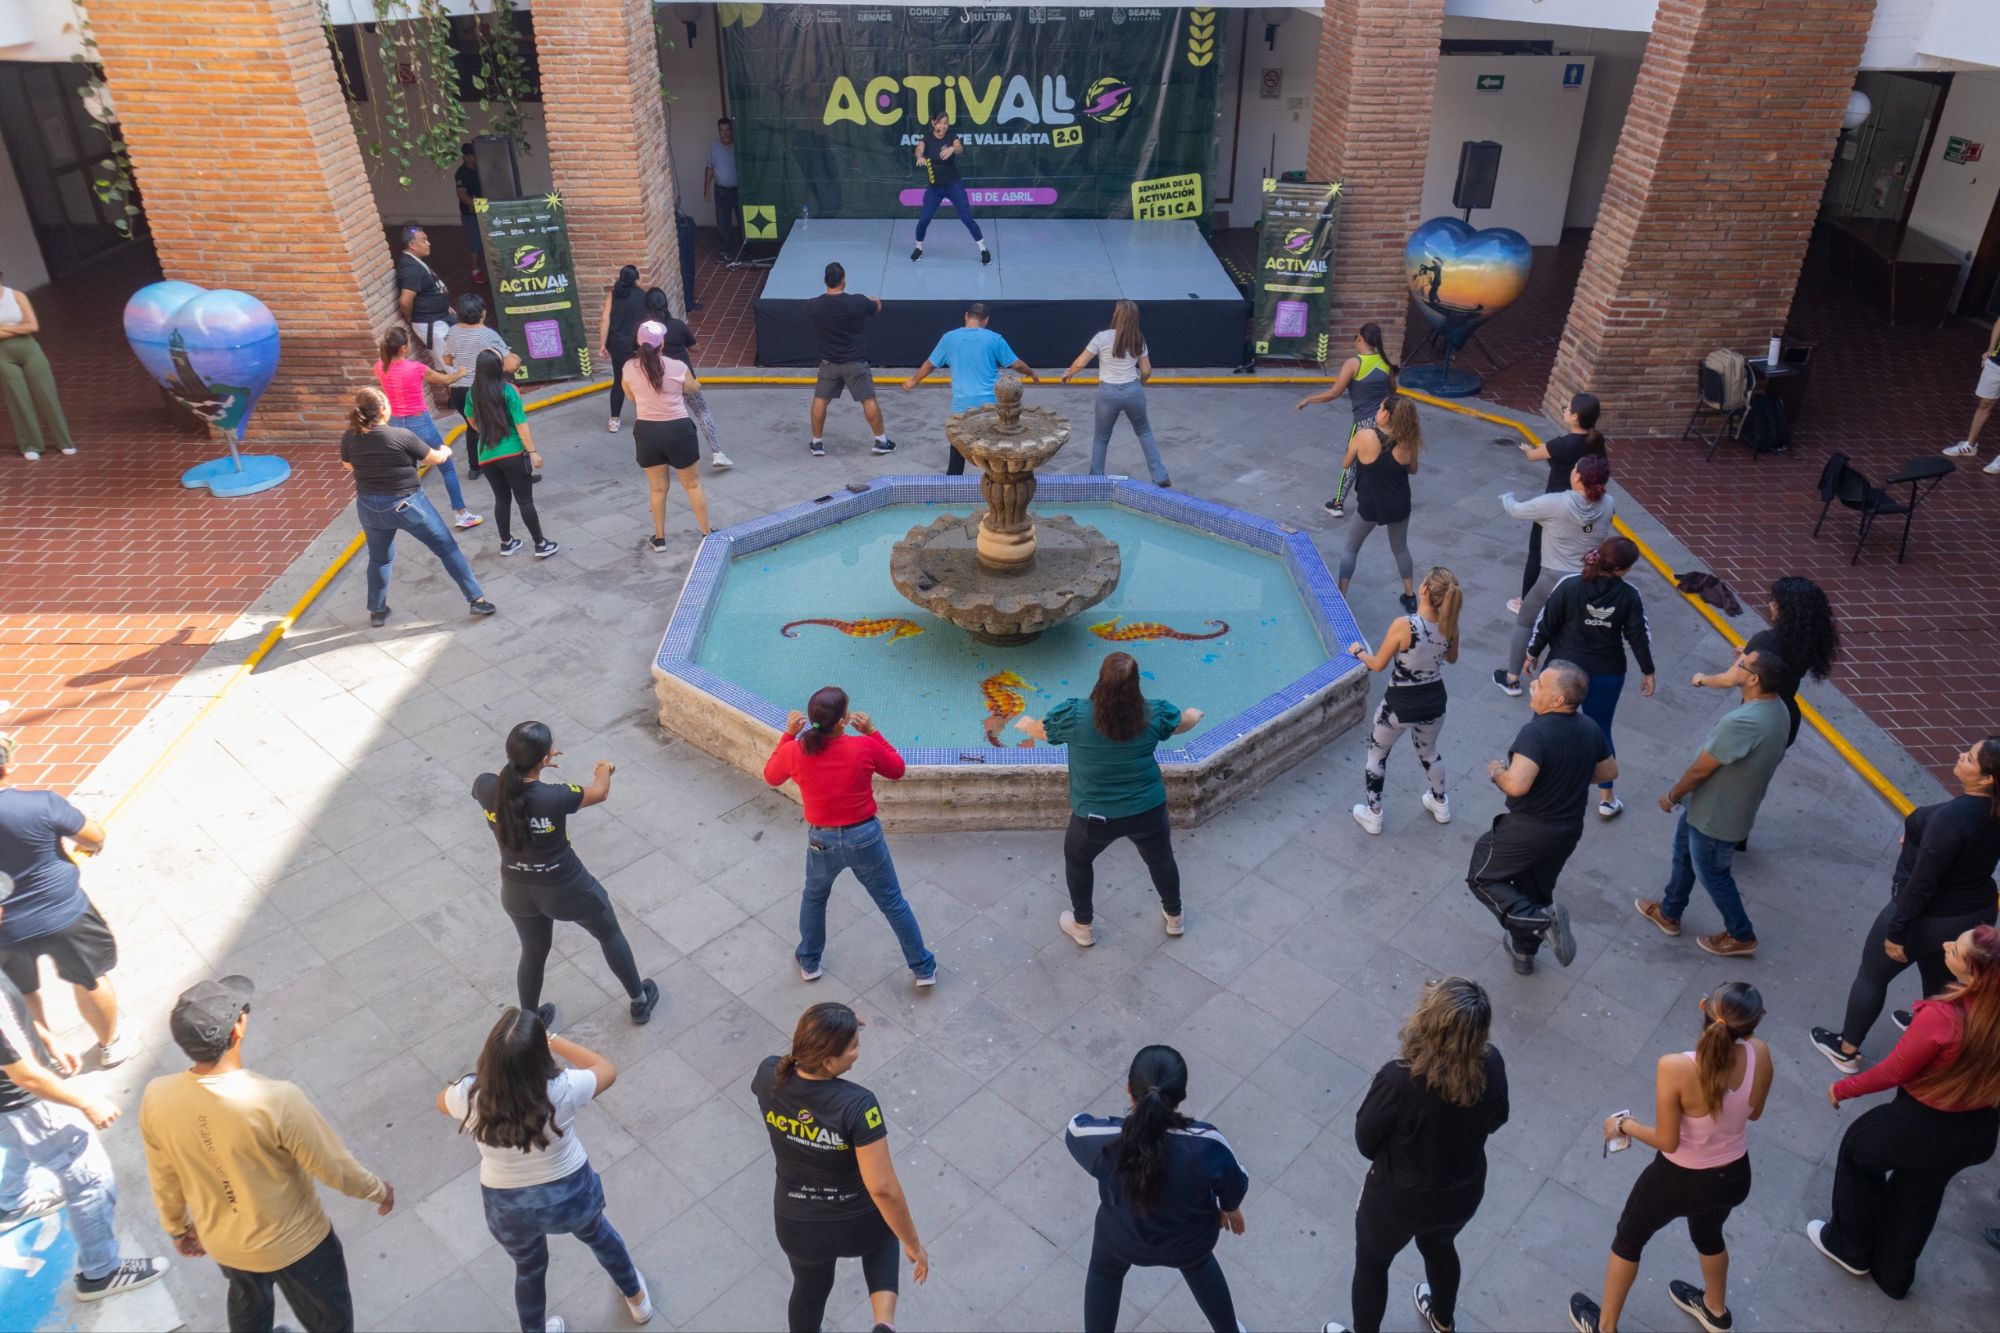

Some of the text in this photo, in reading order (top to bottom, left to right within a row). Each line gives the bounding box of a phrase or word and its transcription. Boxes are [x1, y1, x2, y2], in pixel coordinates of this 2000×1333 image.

[968, 12, 1012, 21] ULTURA
[1080, 9, 1095, 17] DIF
[1128, 8, 1162, 16] SEAPAL
[974, 133, 1050, 145] VALLARTA
[1056, 129, 1080, 144] 2.0
[1138, 178, 1195, 193] SEMANA DE LA
[985, 192, 999, 201] DE
[1001, 191, 1034, 202] ABRIL
[1138, 187, 1195, 204] ACTIVACIÓN
[1140, 201, 1196, 219] FÍSICA
[1584, 618, 1612, 628] adidas
